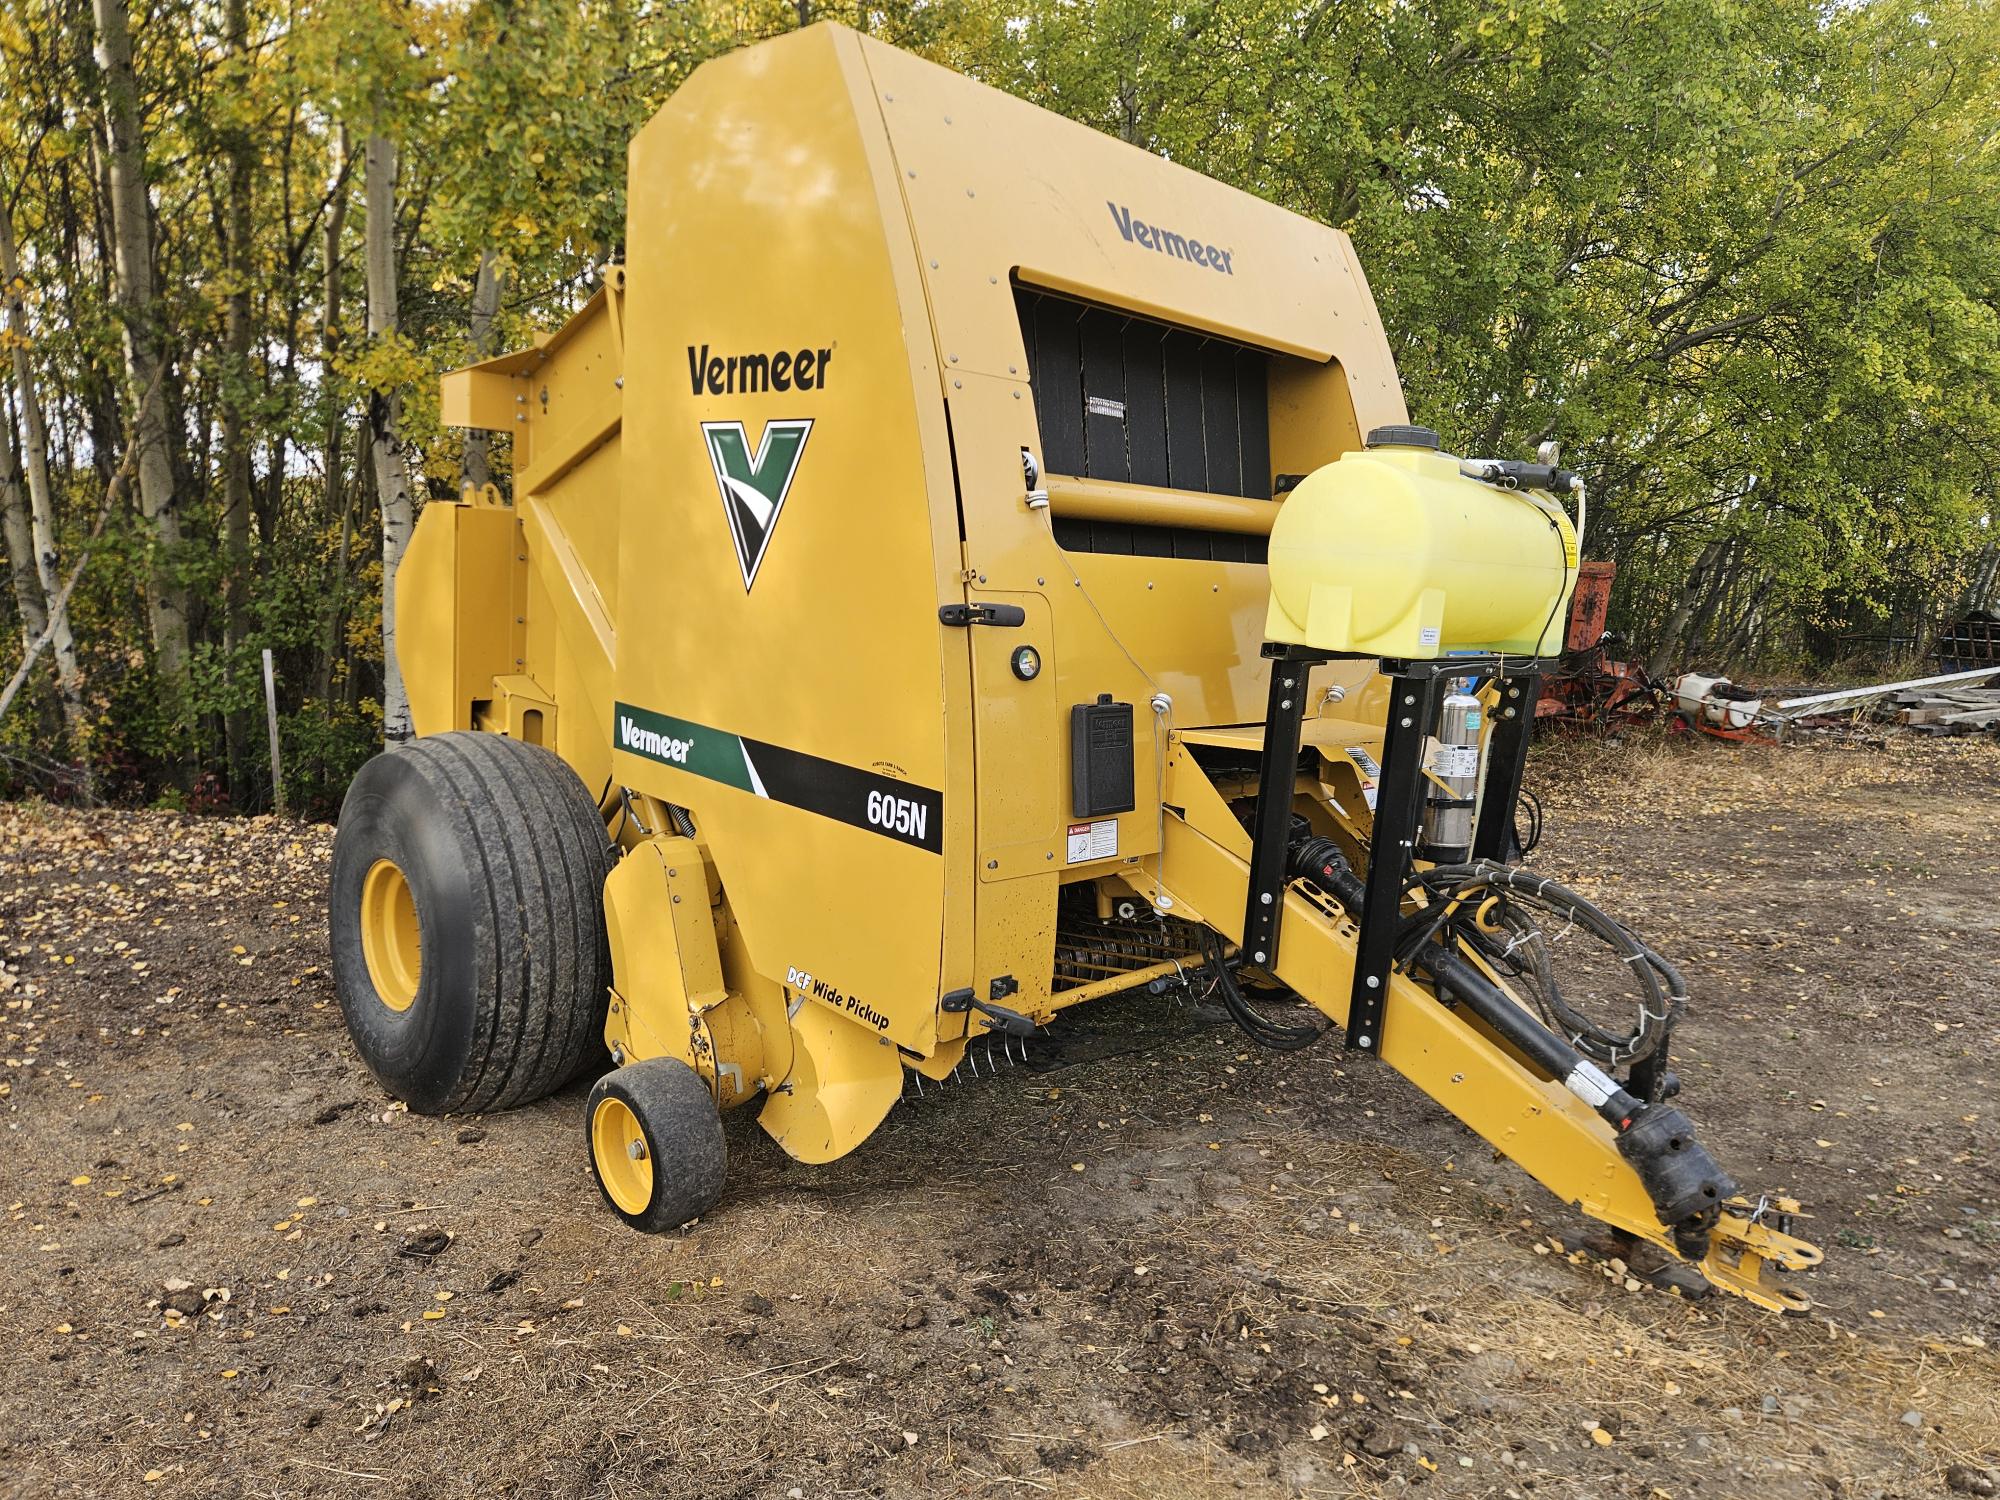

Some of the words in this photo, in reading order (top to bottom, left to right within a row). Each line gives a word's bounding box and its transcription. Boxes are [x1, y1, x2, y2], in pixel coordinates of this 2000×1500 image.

[1106, 201, 1233, 276] Vermeer
[687, 344, 831, 396] Vermeer
[867, 790, 928, 840] 605N
[786, 965, 812, 990] DCF
[813, 979, 844, 1007] Wide
[846, 995, 890, 1031] Pickup
